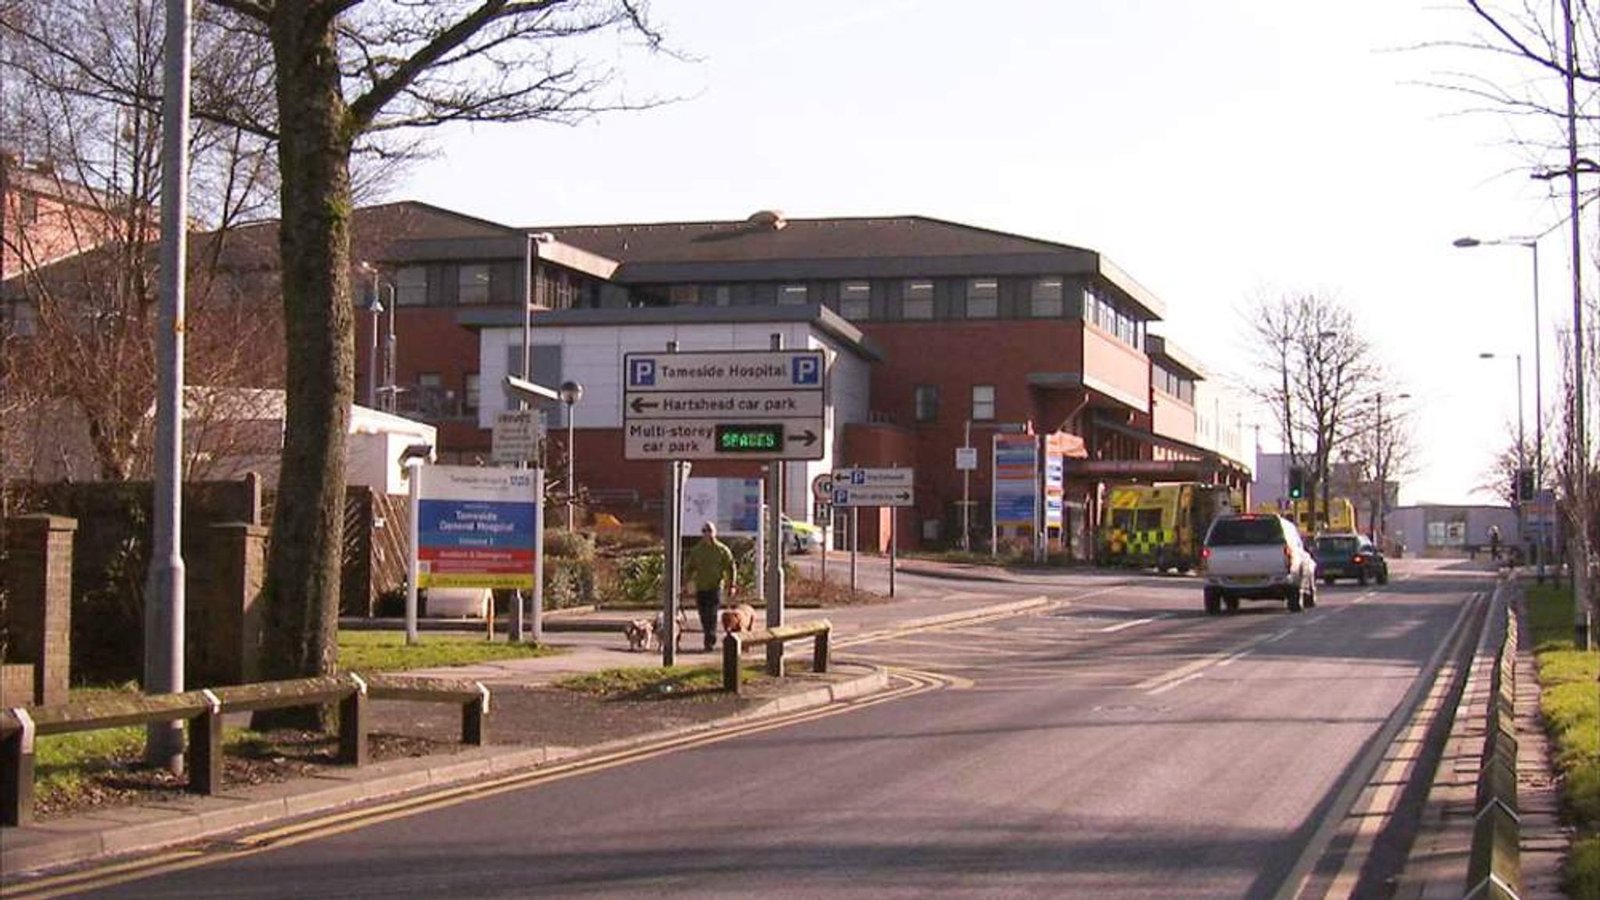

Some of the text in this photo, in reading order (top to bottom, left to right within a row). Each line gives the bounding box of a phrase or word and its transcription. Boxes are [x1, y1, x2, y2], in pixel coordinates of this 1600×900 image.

[661, 365, 725, 379] Tameside
[729, 364, 788, 379] Hospital
[663, 398, 797, 412] Hartshead car park
[630, 425, 714, 439] Multi-storey
[642, 440, 699, 453] car park
[721, 434, 775, 448] SPACES
[455, 510, 498, 521] Tameside
